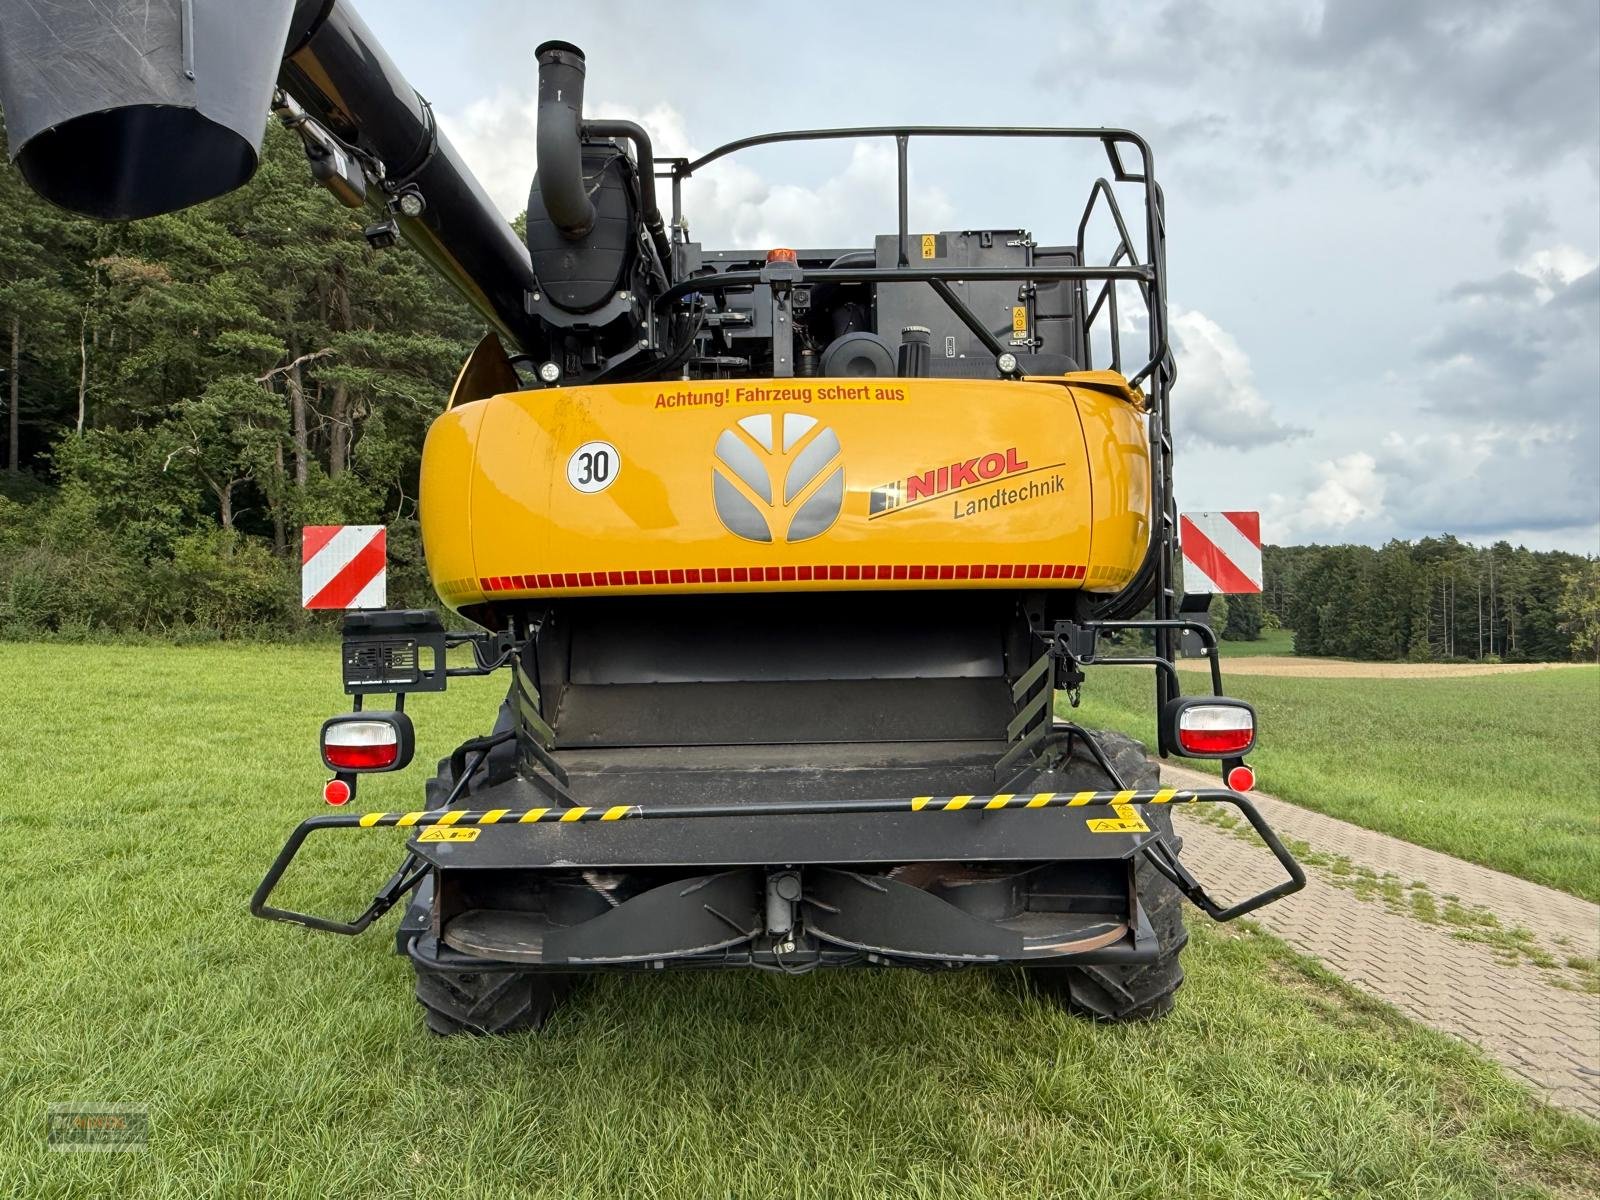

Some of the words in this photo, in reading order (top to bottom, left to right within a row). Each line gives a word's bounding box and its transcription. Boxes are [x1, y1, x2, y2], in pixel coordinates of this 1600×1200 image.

[655, 388, 730, 409] Achtung!
[735, 387, 812, 404] Fahrzeug
[817, 385, 871, 400] schert
[875, 388, 905, 401] aus
[578, 450, 609, 485] 30
[906, 447, 1028, 504] NIKOL
[953, 474, 1065, 520] Landtechnik
